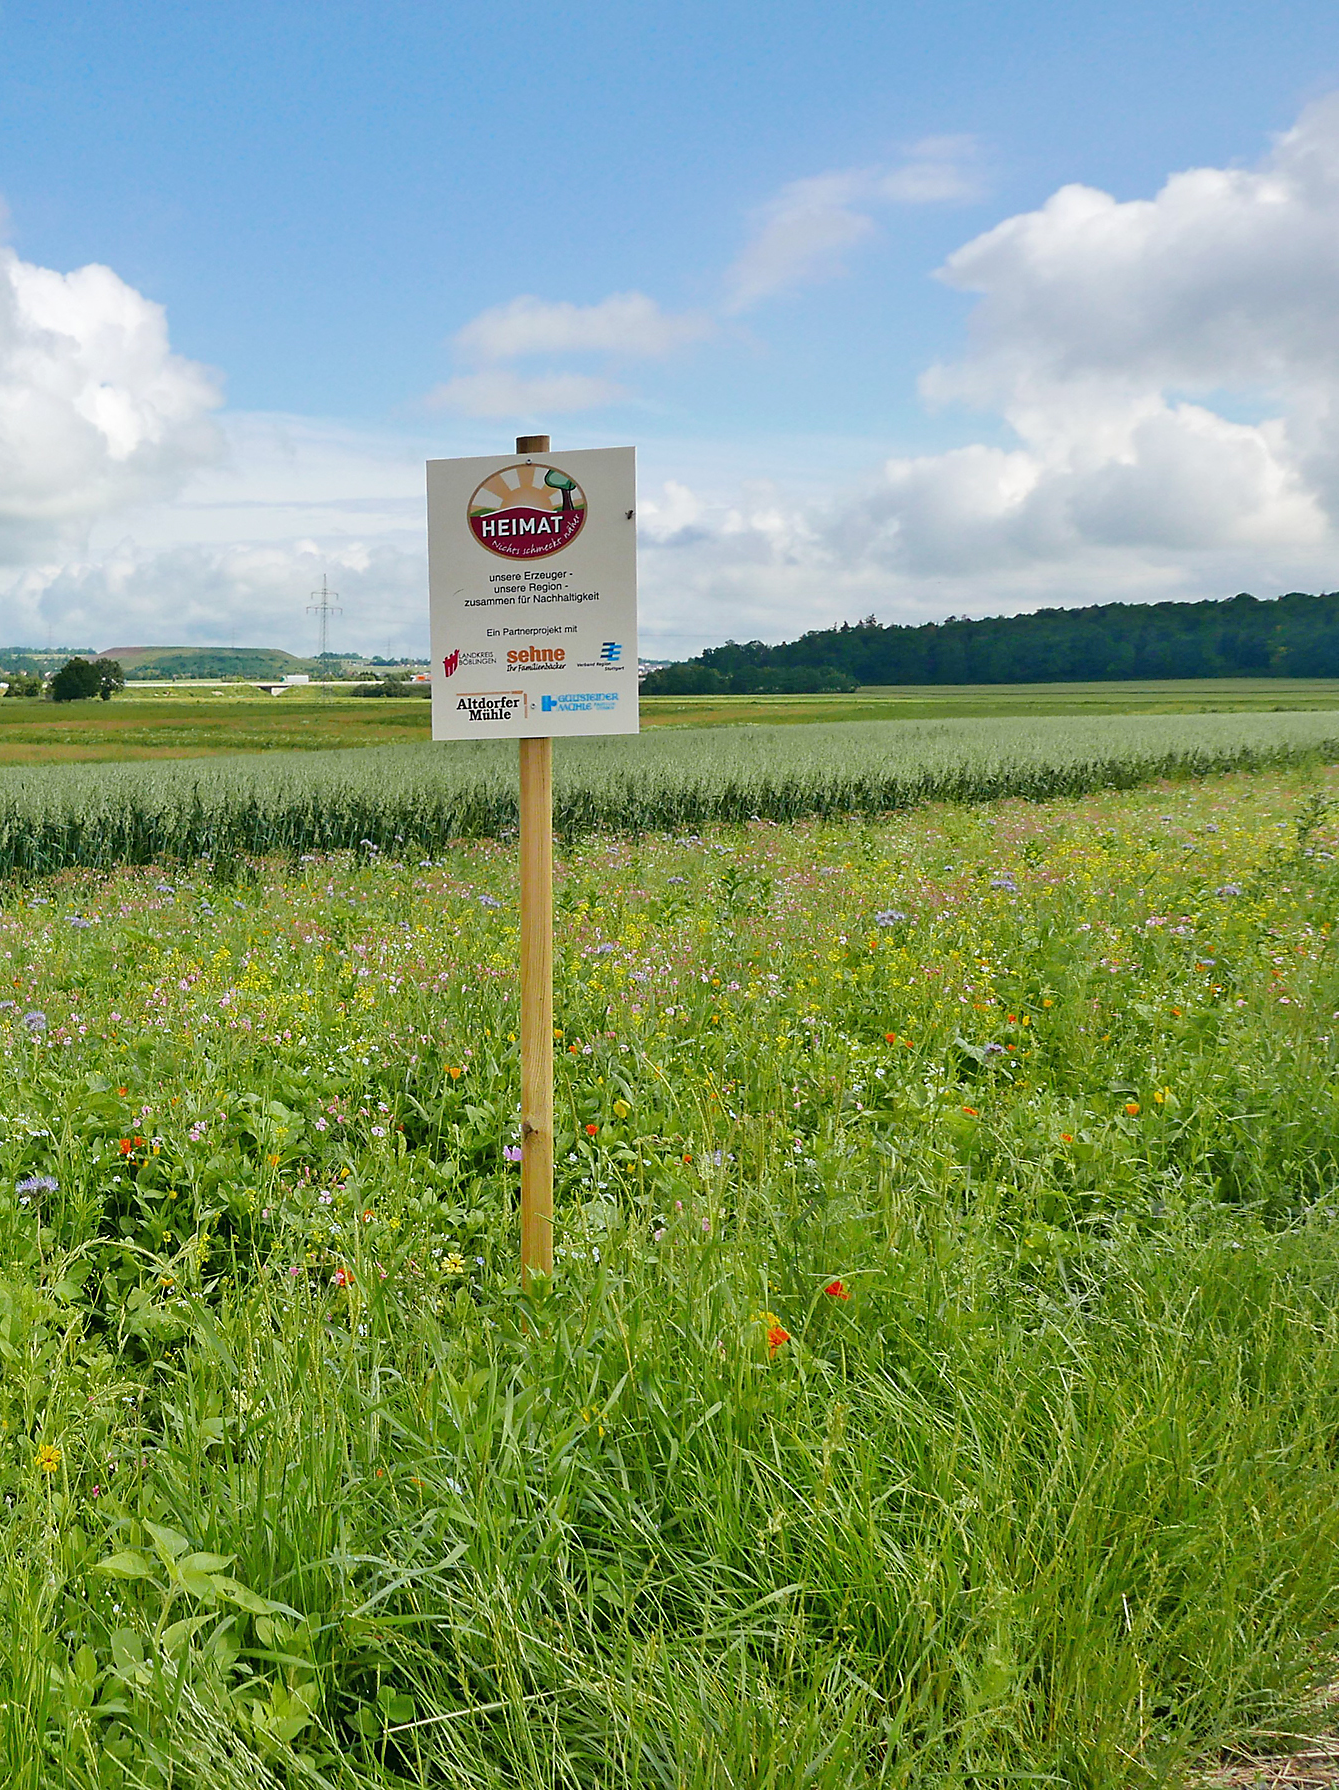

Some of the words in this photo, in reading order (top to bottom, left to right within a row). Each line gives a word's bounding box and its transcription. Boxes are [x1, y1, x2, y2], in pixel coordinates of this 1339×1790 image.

[482, 515, 564, 538] HEIMAT
[522, 537, 562, 555] schmeckt
[563, 513, 580, 539] näher
[489, 573, 522, 583] unsere
[524, 570, 567, 583] Erzeuger
[494, 584, 526, 594] unsere
[529, 582, 562, 594] Region
[464, 596, 515, 607] zusammen
[518, 593, 531, 604] für
[533, 591, 600, 604] Nachhaltigkeit
[487, 628, 500, 637] Ein
[502, 626, 562, 637] Partnerprojekt
[564, 625, 578, 634] mit
[459, 651, 494, 659] LANDKREIS
[506, 645, 566, 663] sehne
[459, 658, 497, 666] BÖBLINGEN
[506, 664, 518, 672] Ihr
[518, 662, 567, 672] Familienbäcker
[456, 696, 520, 710] Altdorfer
[469, 709, 512, 721] Mühle
